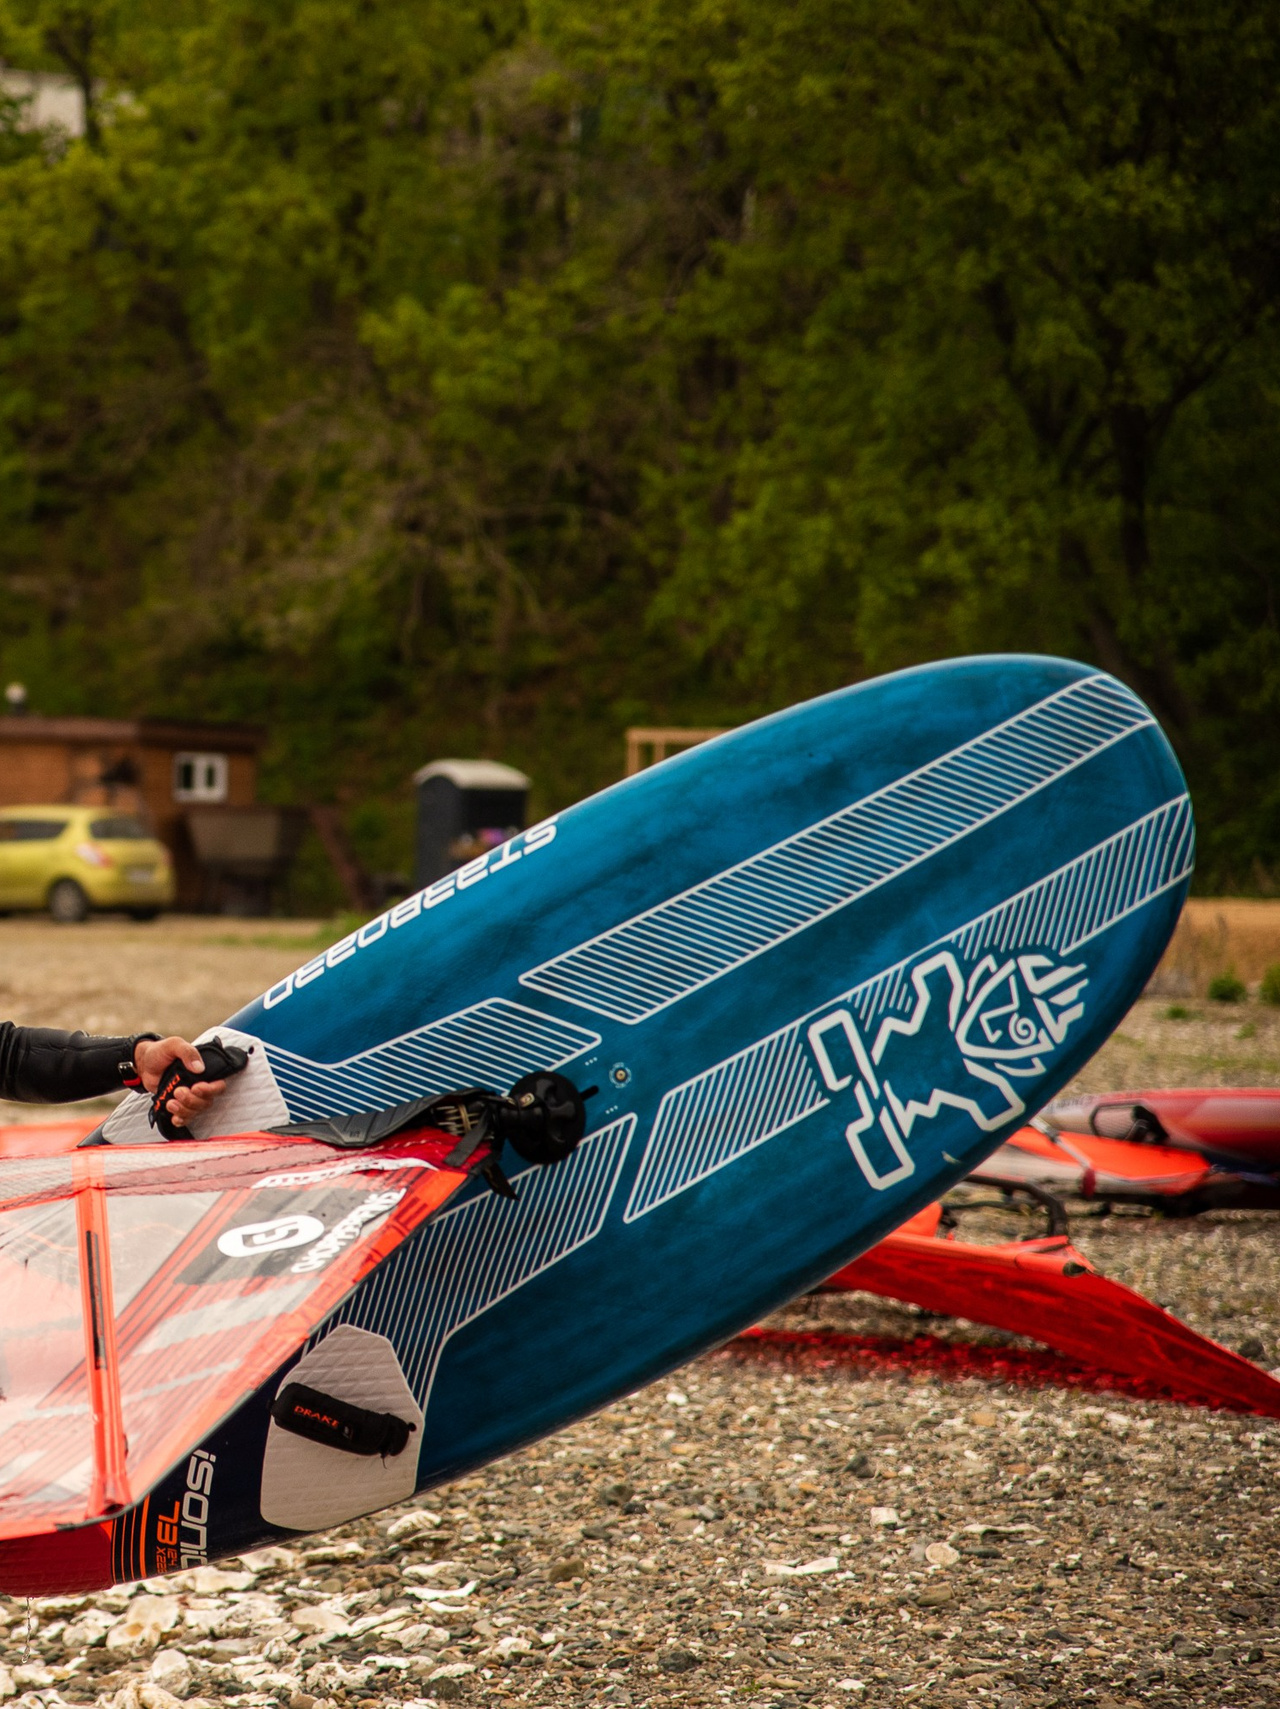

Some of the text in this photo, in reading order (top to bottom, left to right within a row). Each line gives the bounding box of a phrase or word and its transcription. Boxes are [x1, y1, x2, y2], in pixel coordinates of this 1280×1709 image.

[263, 814, 558, 1010] STARBOARD
[293, 1405, 340, 1429] DRAKE
[156, 1501, 181, 1546] 73
